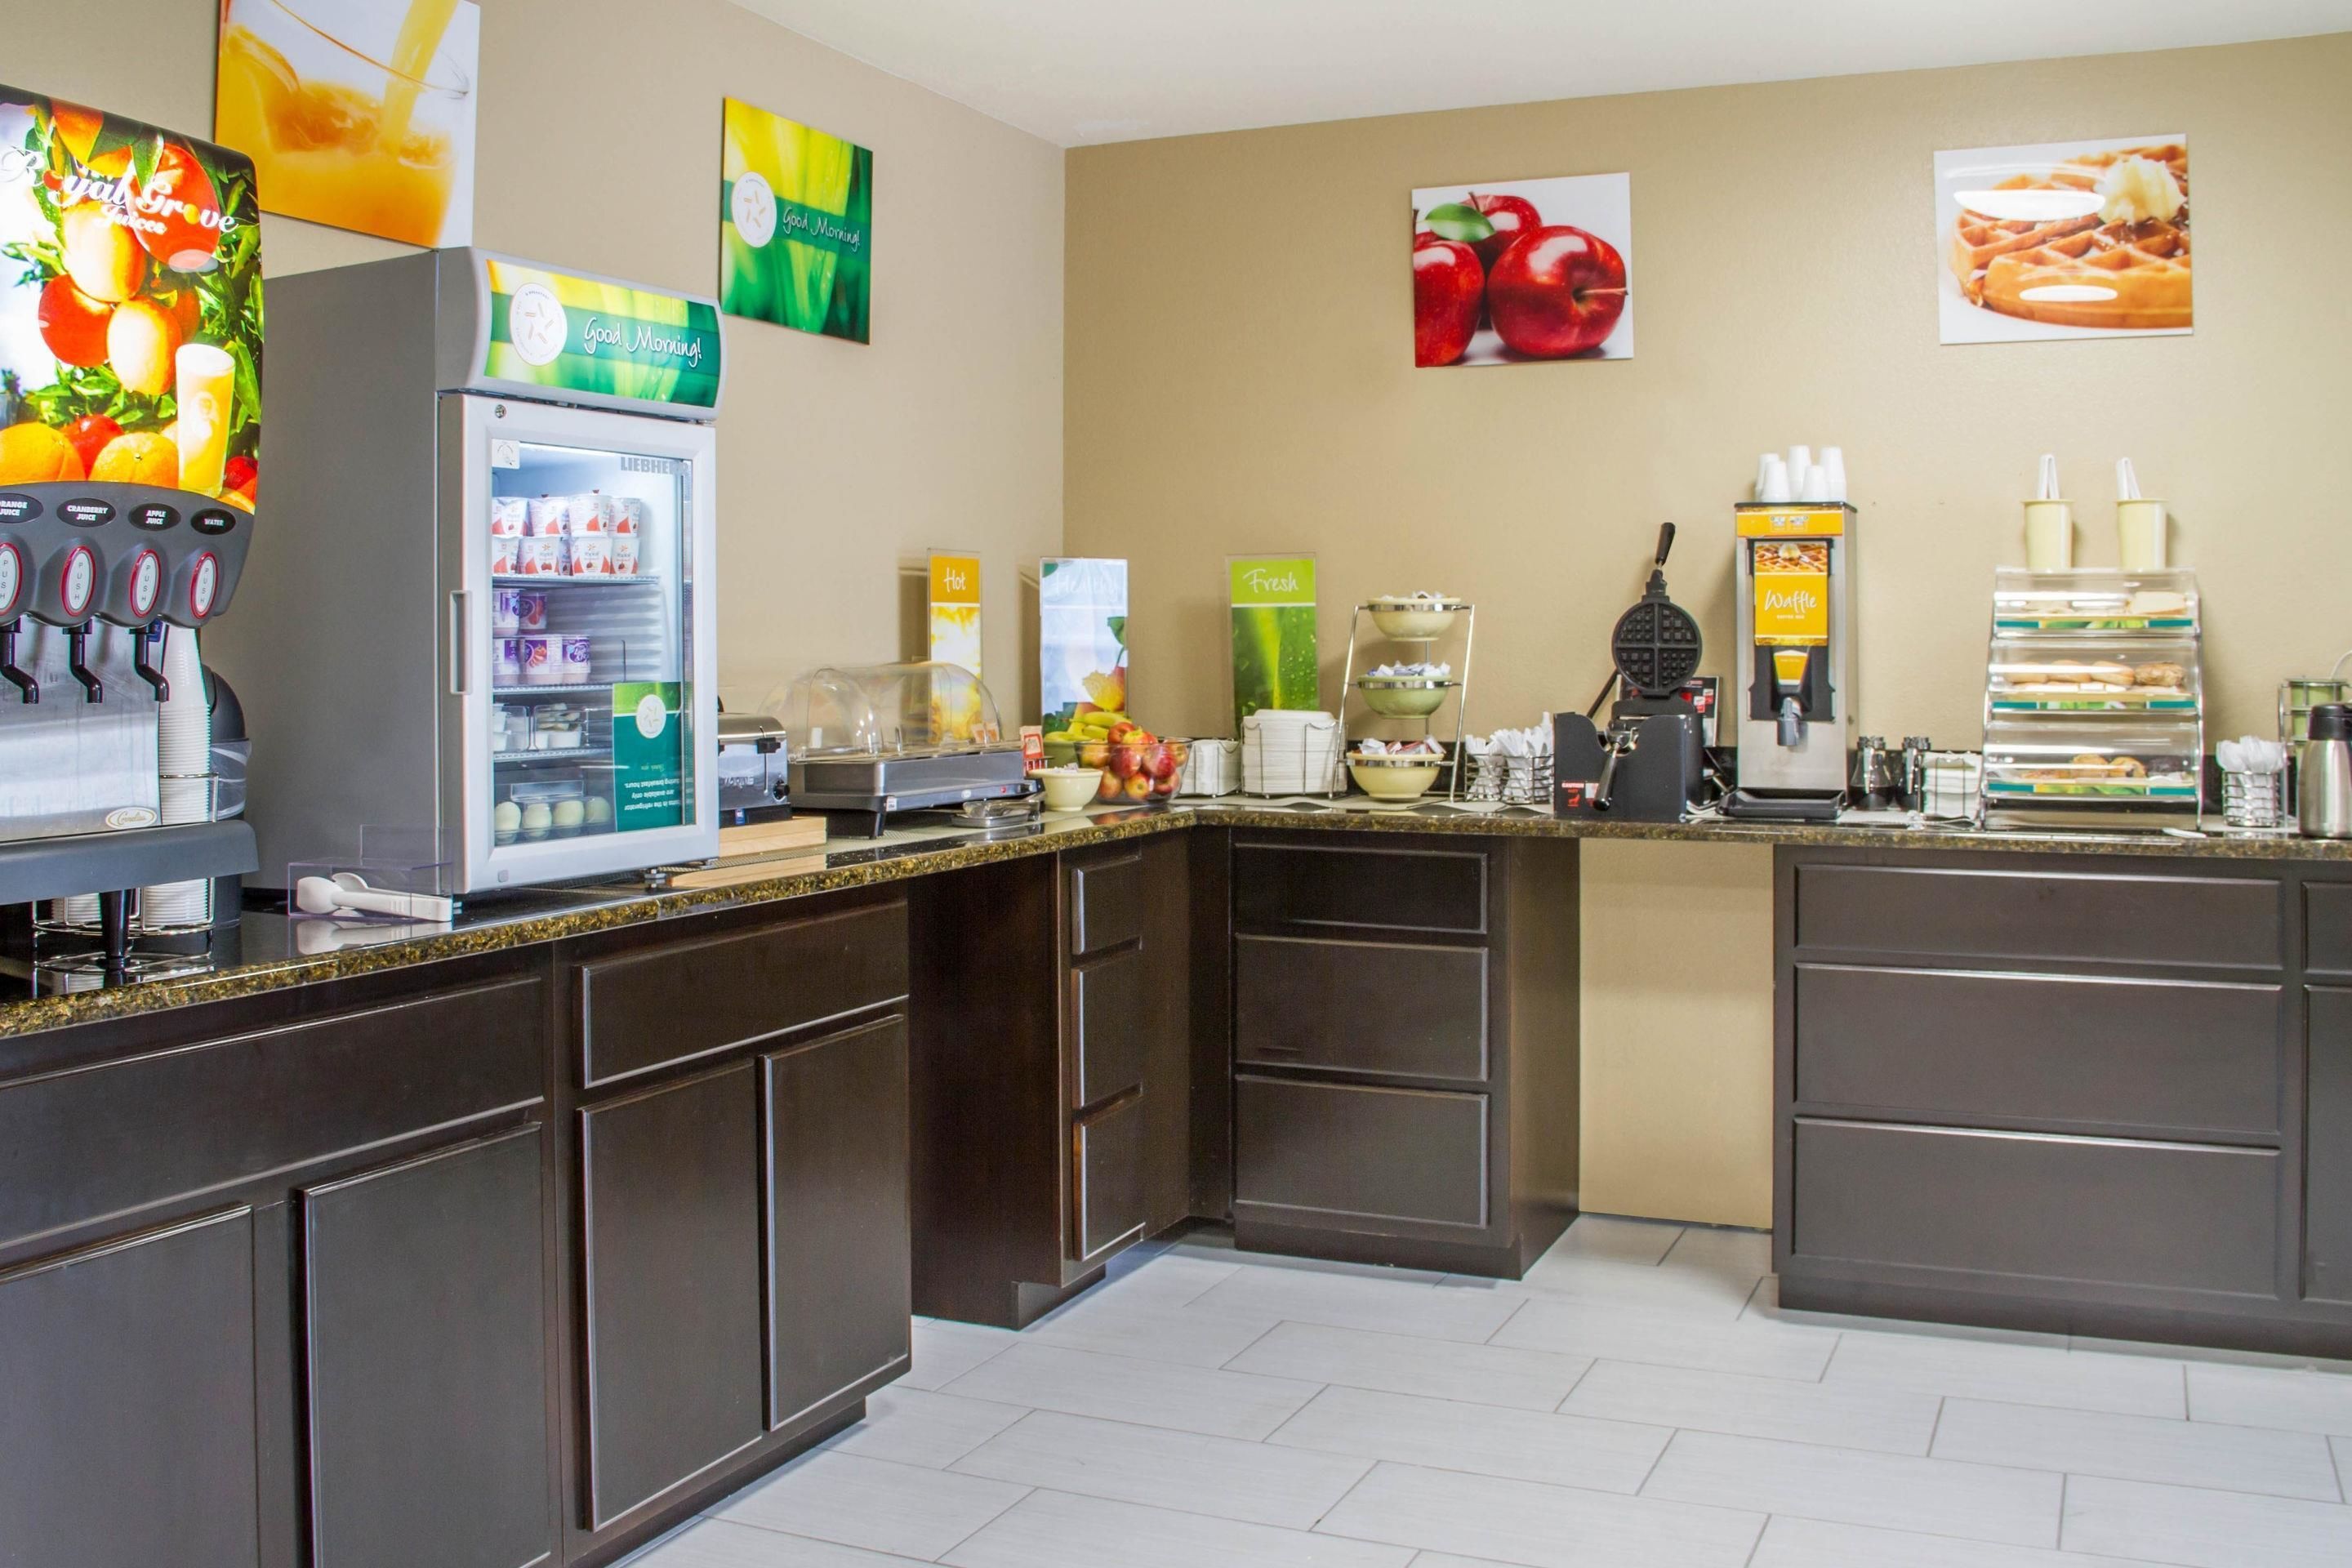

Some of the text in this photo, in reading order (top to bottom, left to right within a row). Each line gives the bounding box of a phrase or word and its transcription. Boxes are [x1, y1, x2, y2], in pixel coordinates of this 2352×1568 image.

[135, 180, 239, 234] Grove
[782, 206, 861, 252] Good Morning!
[584, 316, 702, 368] Good Morning!
[0, 501, 28, 509] RANGE
[67, 505, 108, 514] CRANBERRY
[76, 513, 96, 521] JUICE
[146, 510, 167, 518] APPLE
[204, 518, 225, 526] WATER
[943, 567, 966, 592] Hot
[1243, 568, 1299, 594] Fresh
[1764, 589, 1818, 614] Waffle
